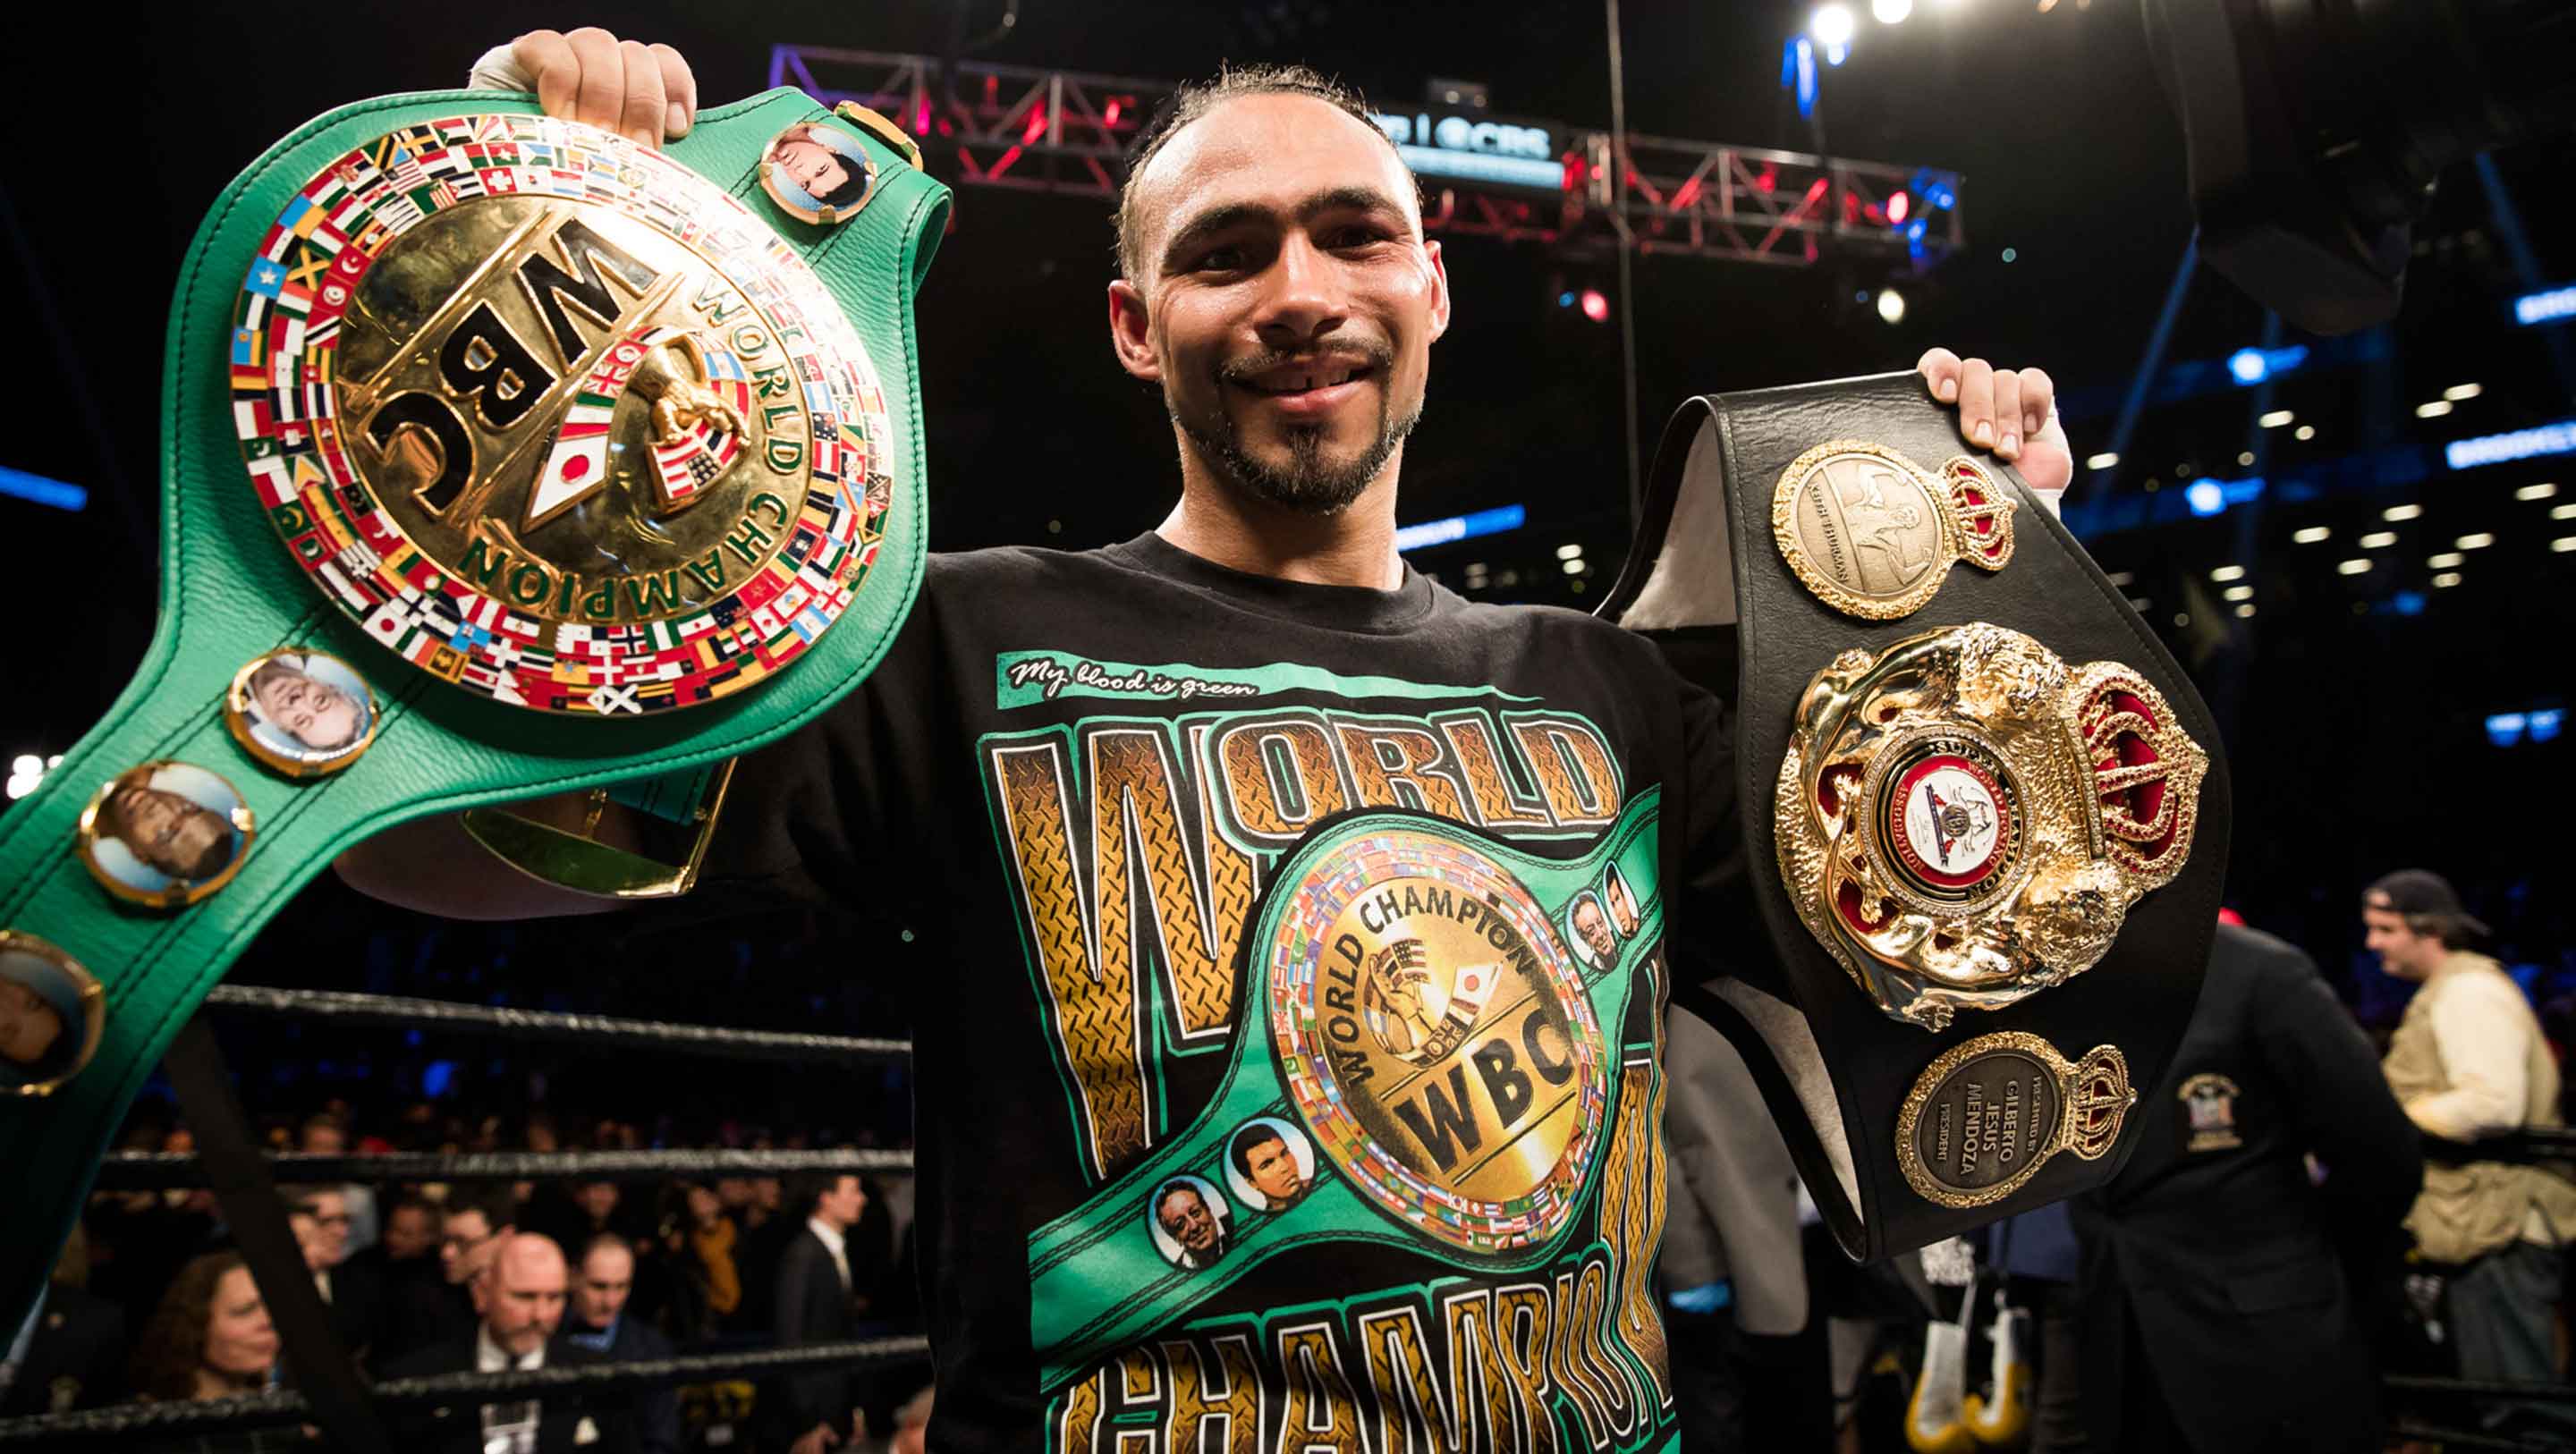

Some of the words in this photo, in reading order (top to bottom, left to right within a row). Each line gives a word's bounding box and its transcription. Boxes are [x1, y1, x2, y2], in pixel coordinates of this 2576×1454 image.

[359, 216, 662, 517] WBC
[692, 274, 803, 475] WORLD
[455, 492, 789, 621] CHAMPION
[1809, 484, 1829, 518] KEITH
[1822, 520, 1850, 583] THURMAN
[1010, 660, 1067, 697] My
[1077, 664, 1145, 690] blood
[1151, 676, 1176, 693] is
[1181, 679, 1256, 698] green
[989, 718, 1623, 1179] WORLD
[1325, 933, 1376, 1088] WORLD
[1360, 885, 1538, 976] CHAMPION
[1392, 1008, 1576, 1176] WBC
[1936, 1103, 1951, 1162] PRESIDENT
[1960, 1083, 1983, 1176] MENDOZA
[1982, 1102, 2000, 1152] JESUS
[2000, 1079, 2020, 1162] GILBERTO
